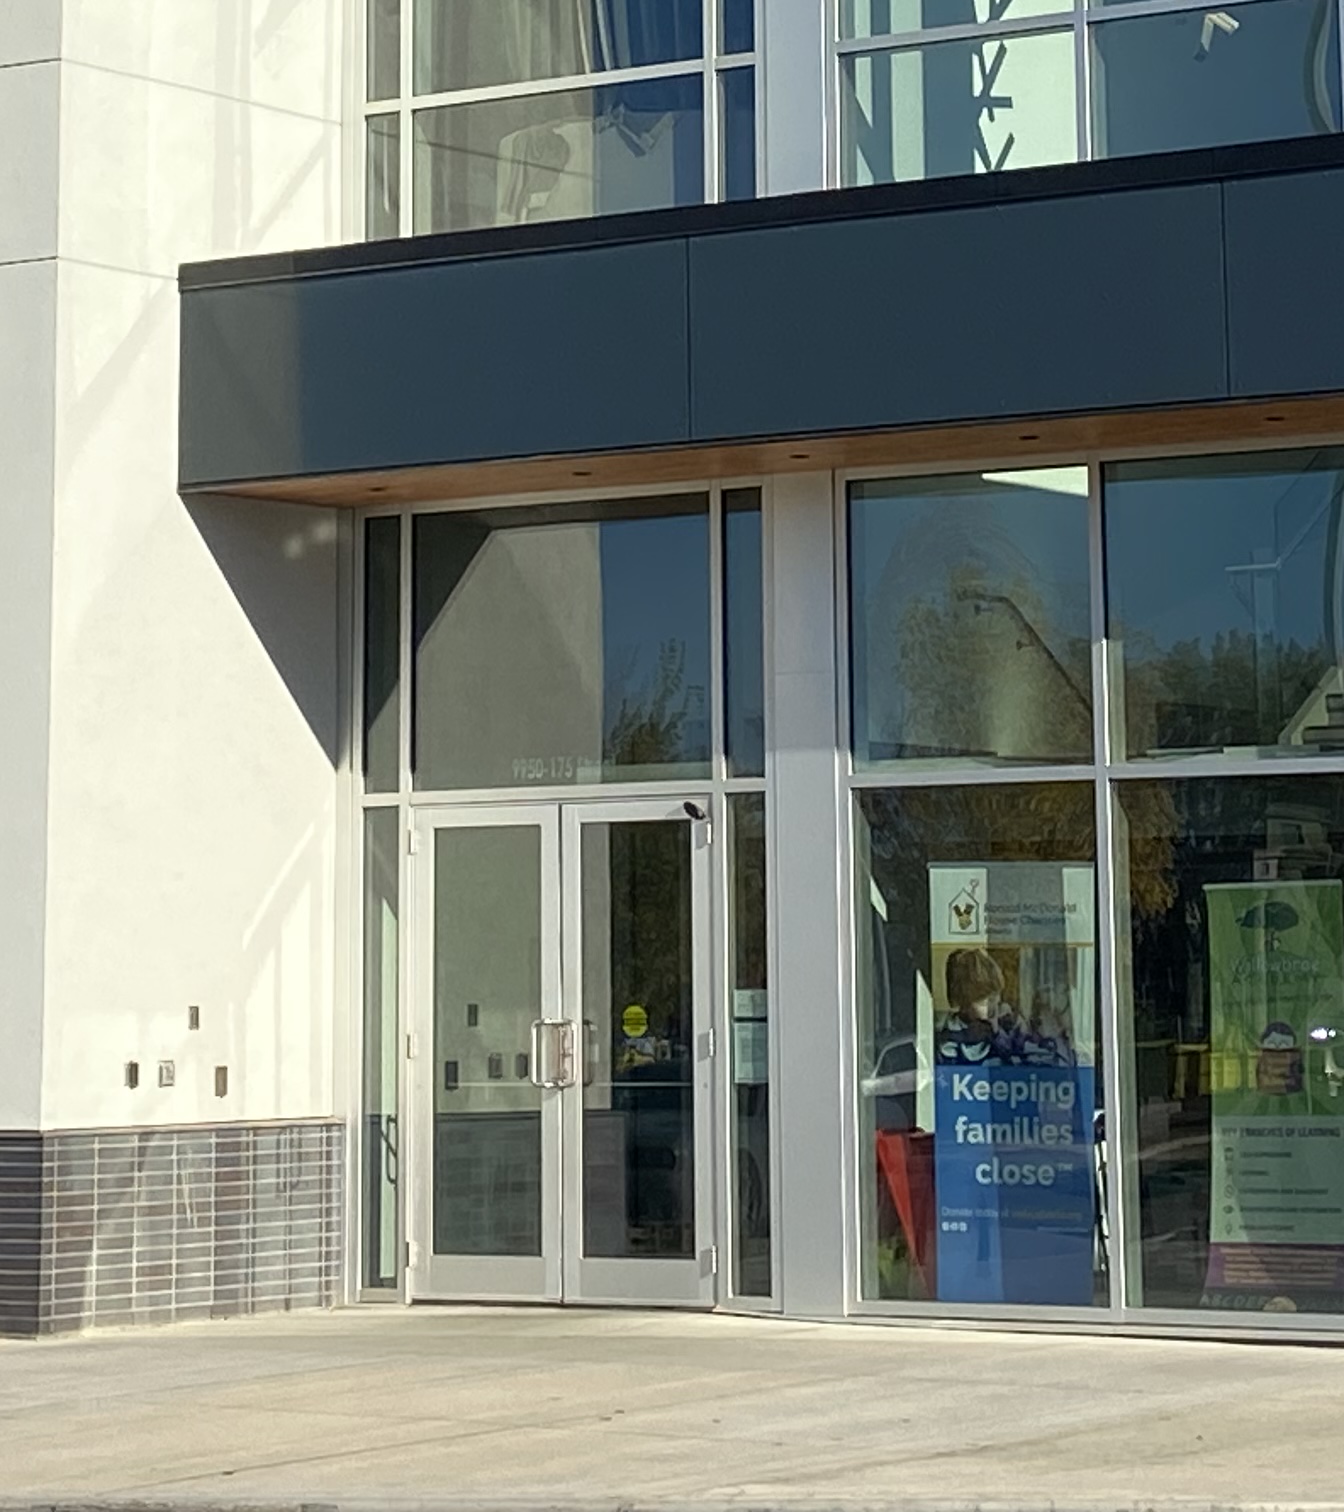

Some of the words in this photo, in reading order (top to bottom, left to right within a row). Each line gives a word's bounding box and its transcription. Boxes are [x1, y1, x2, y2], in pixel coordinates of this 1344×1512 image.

[512, 756, 574, 780] 9950-175
[952, 1073, 1076, 1109] Keeping
[955, 1115, 1074, 1146] families
